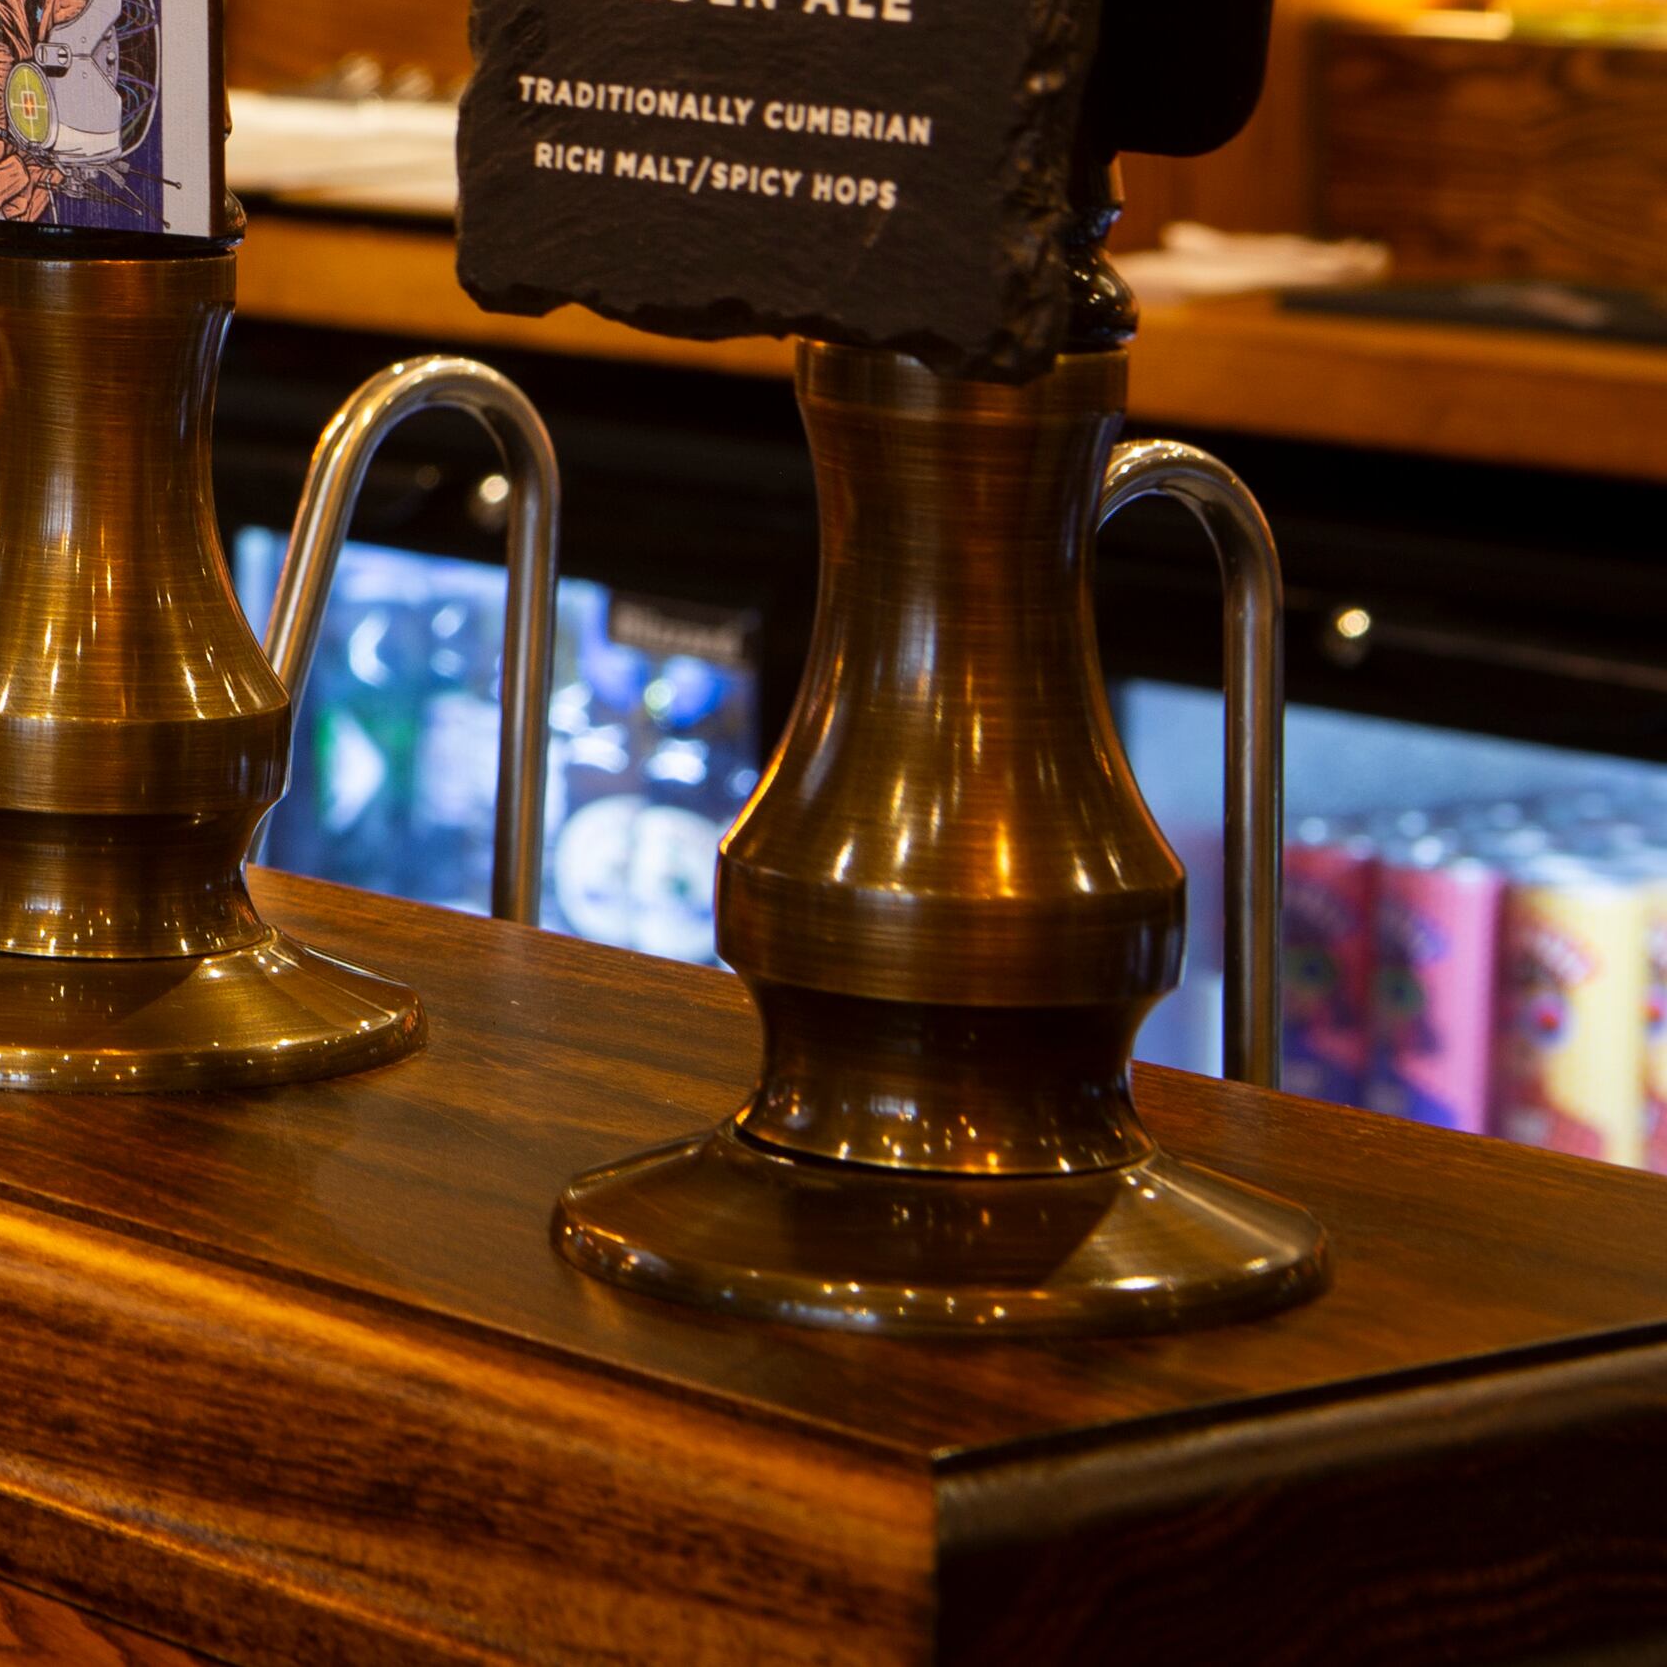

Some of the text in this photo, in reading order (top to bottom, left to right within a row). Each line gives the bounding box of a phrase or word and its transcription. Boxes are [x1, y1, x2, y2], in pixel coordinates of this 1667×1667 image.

[518, 75, 933, 146] TRADITIONALLY CUMBRIAN
[533, 141, 899, 211] RICH MALT/SPICY HOPS
